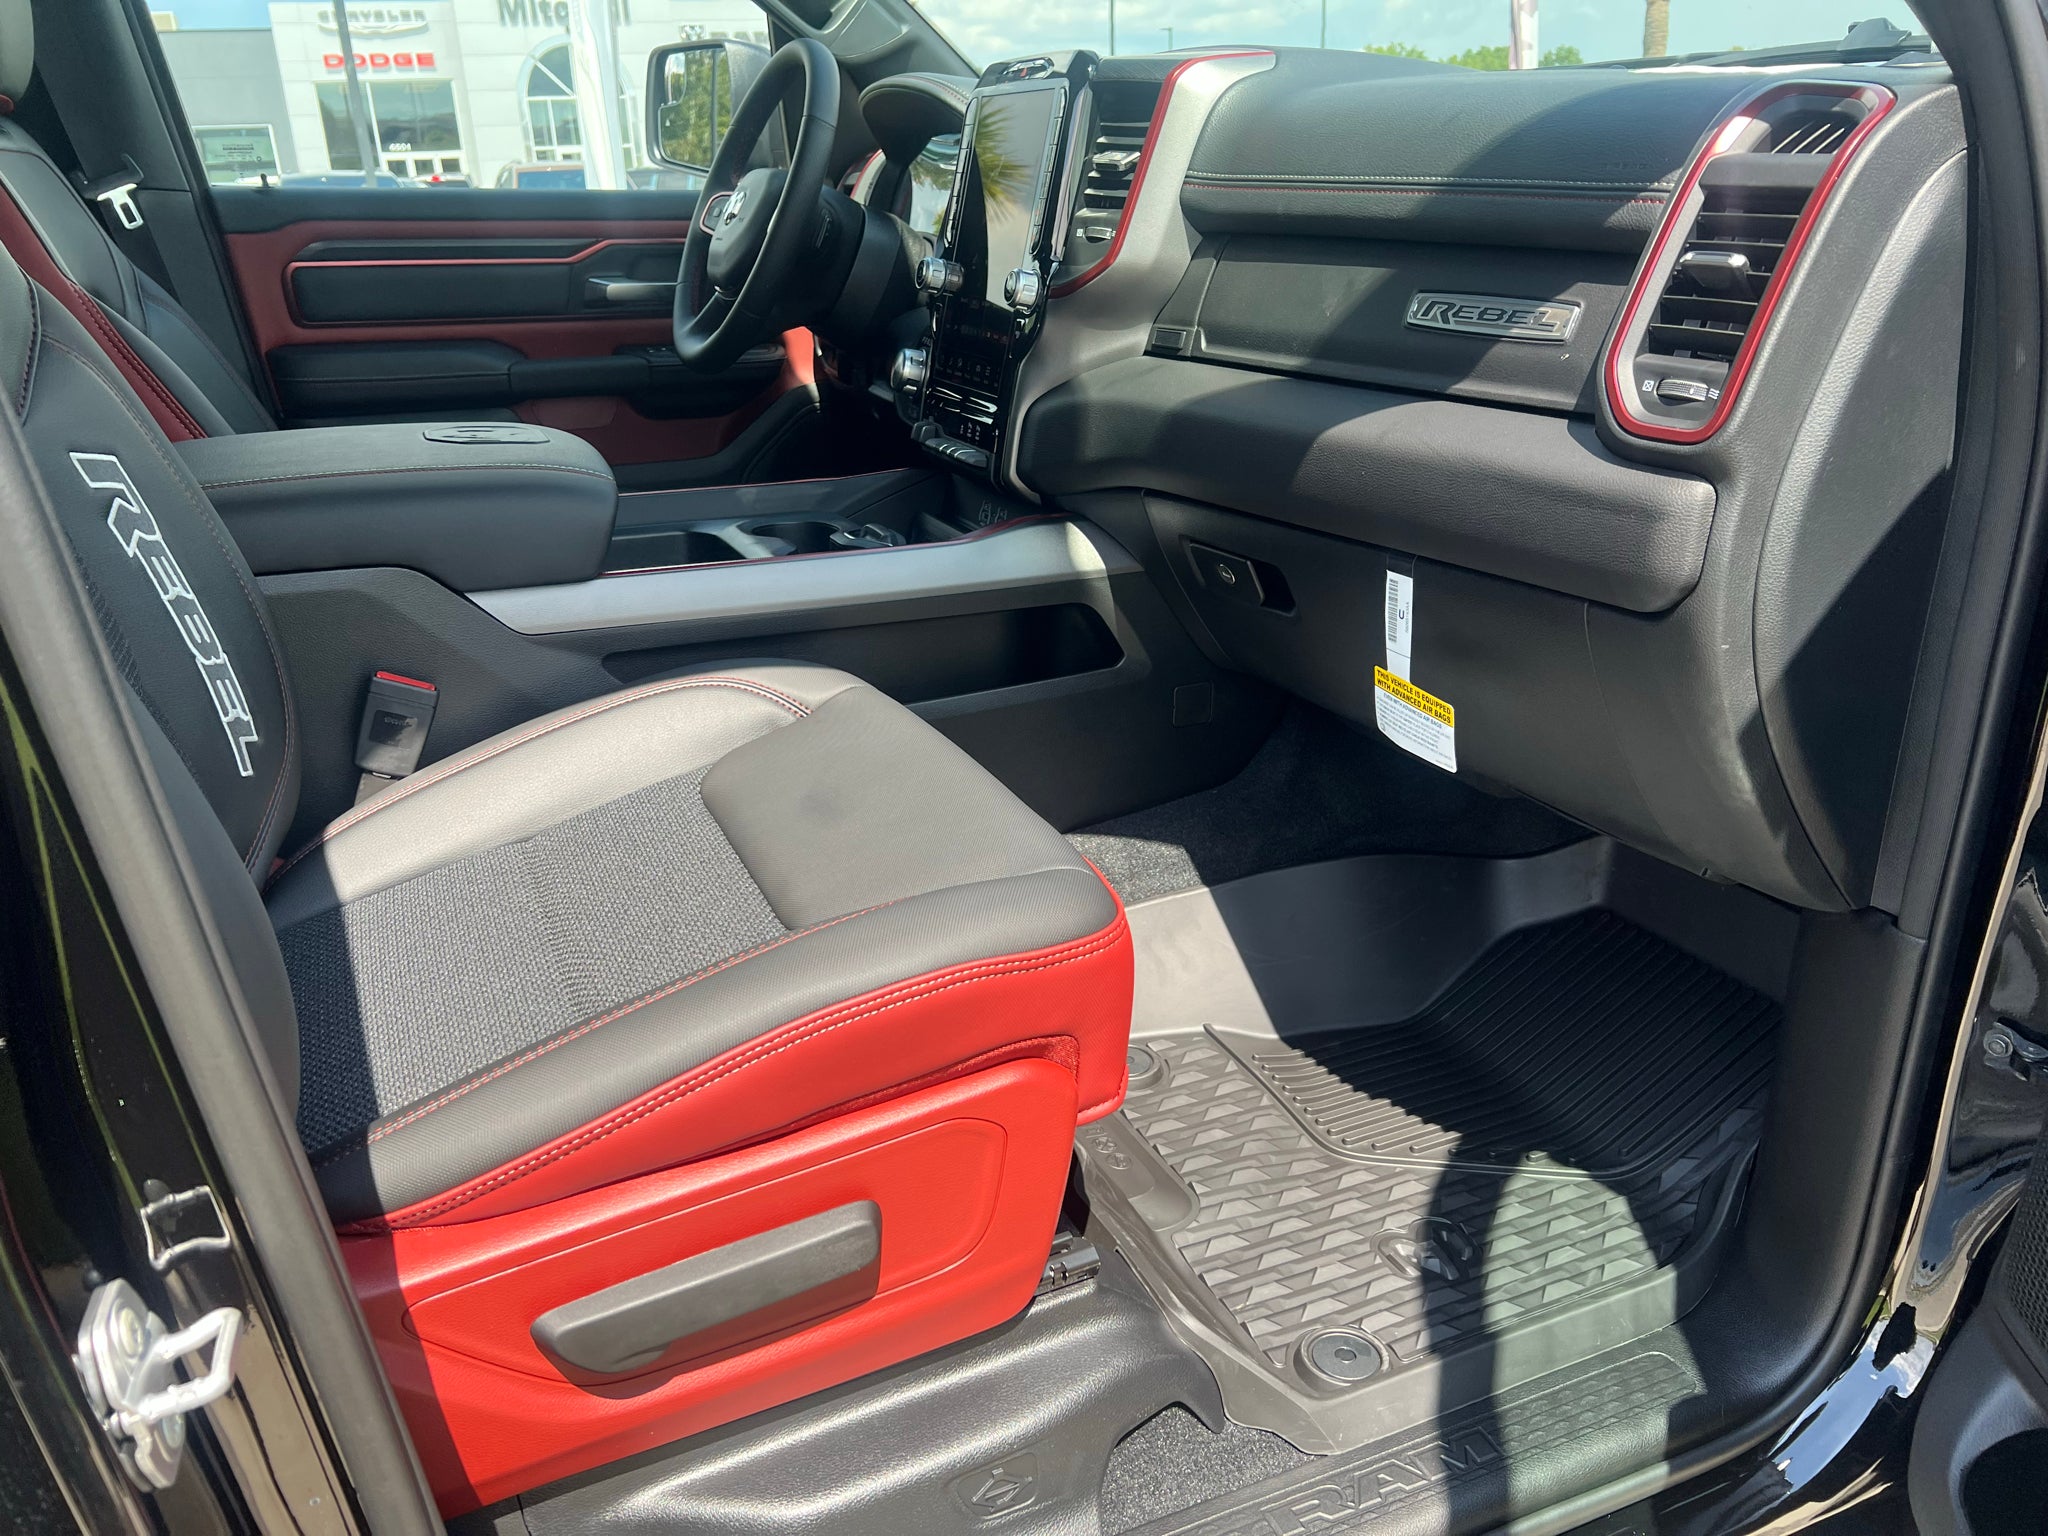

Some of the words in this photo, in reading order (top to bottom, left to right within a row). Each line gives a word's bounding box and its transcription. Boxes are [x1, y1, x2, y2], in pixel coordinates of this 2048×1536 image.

[323, 52, 436, 69] DODGE
[1418, 300, 1558, 333] REBEL
[68, 451, 258, 777] REBEL
[1377, 669, 1390, 681] THIS
[1391, 676, 1414, 694] VEHICLE
[1414, 688, 1421, 699] IS
[1421, 693, 1451, 715] EQUIPPED
[1377, 678, 1391, 691] WITH
[1391, 685, 1422, 708] ADVANCED
[1422, 704, 1433, 715] AIR
[1434, 709, 1451, 724] BAGS
[1259, 1426, 1504, 1536] RAM
